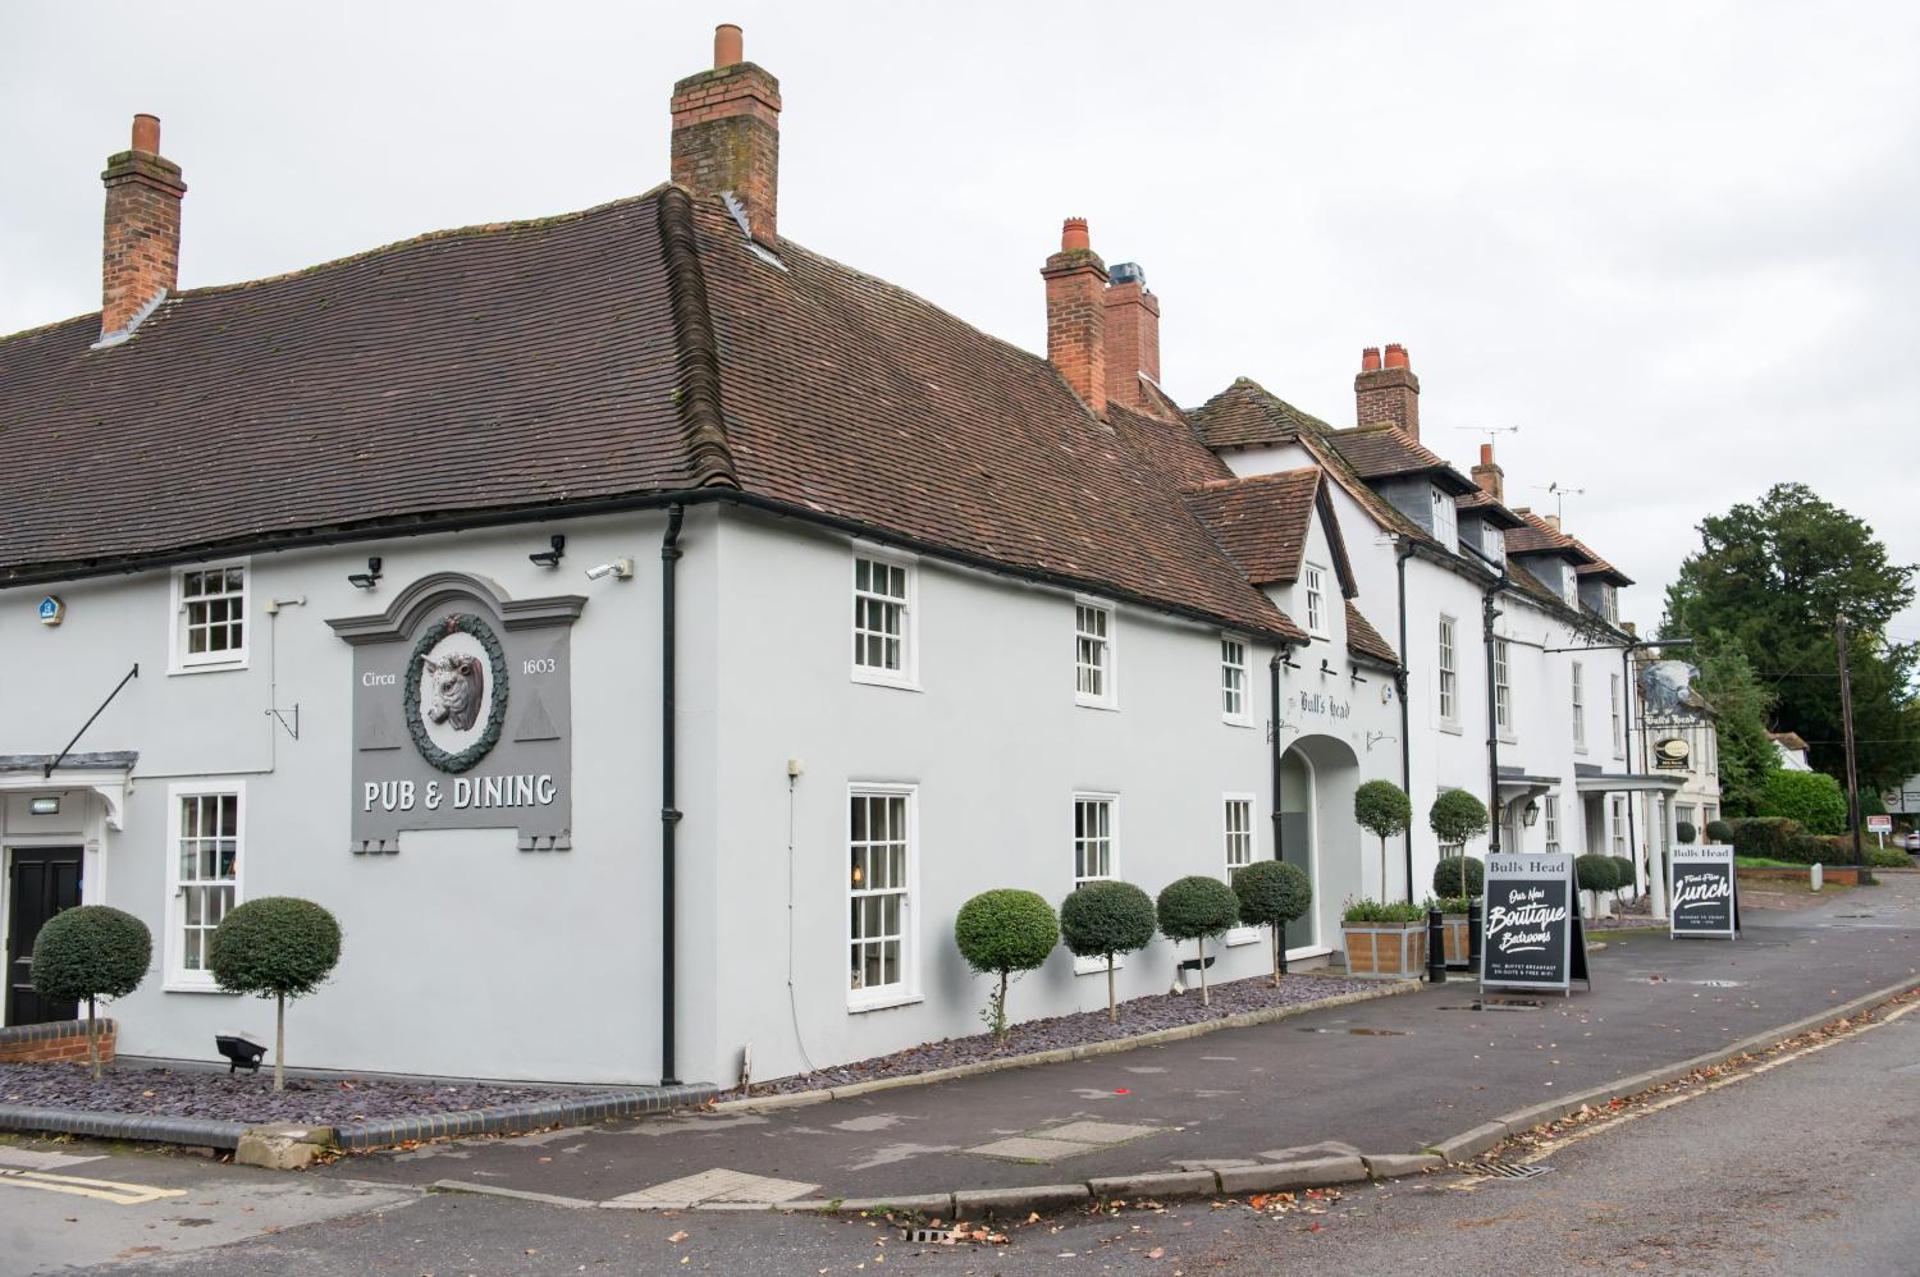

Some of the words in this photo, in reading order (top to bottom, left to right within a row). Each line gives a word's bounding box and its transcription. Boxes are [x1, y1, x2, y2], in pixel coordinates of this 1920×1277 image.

[362, 672, 395, 687] Circa
[523, 658, 556, 675] 1603
[364, 780, 416, 812] PUB
[425, 781, 443, 810] &
[454, 774, 558, 810] DINING
[1701, 848, 1729, 857] Head
[1490, 861, 1524, 873] Bulls
[1530, 861, 1565, 873] Head
[1509, 889, 1526, 904] Our
[1528, 887, 1545, 902] New
[1674, 876, 1731, 911] Lunch
[1486, 901, 1567, 940] Boutique
[1499, 931, 1551, 951] Bedrooms
[1525, 963, 1556, 971] BREAKFAST
